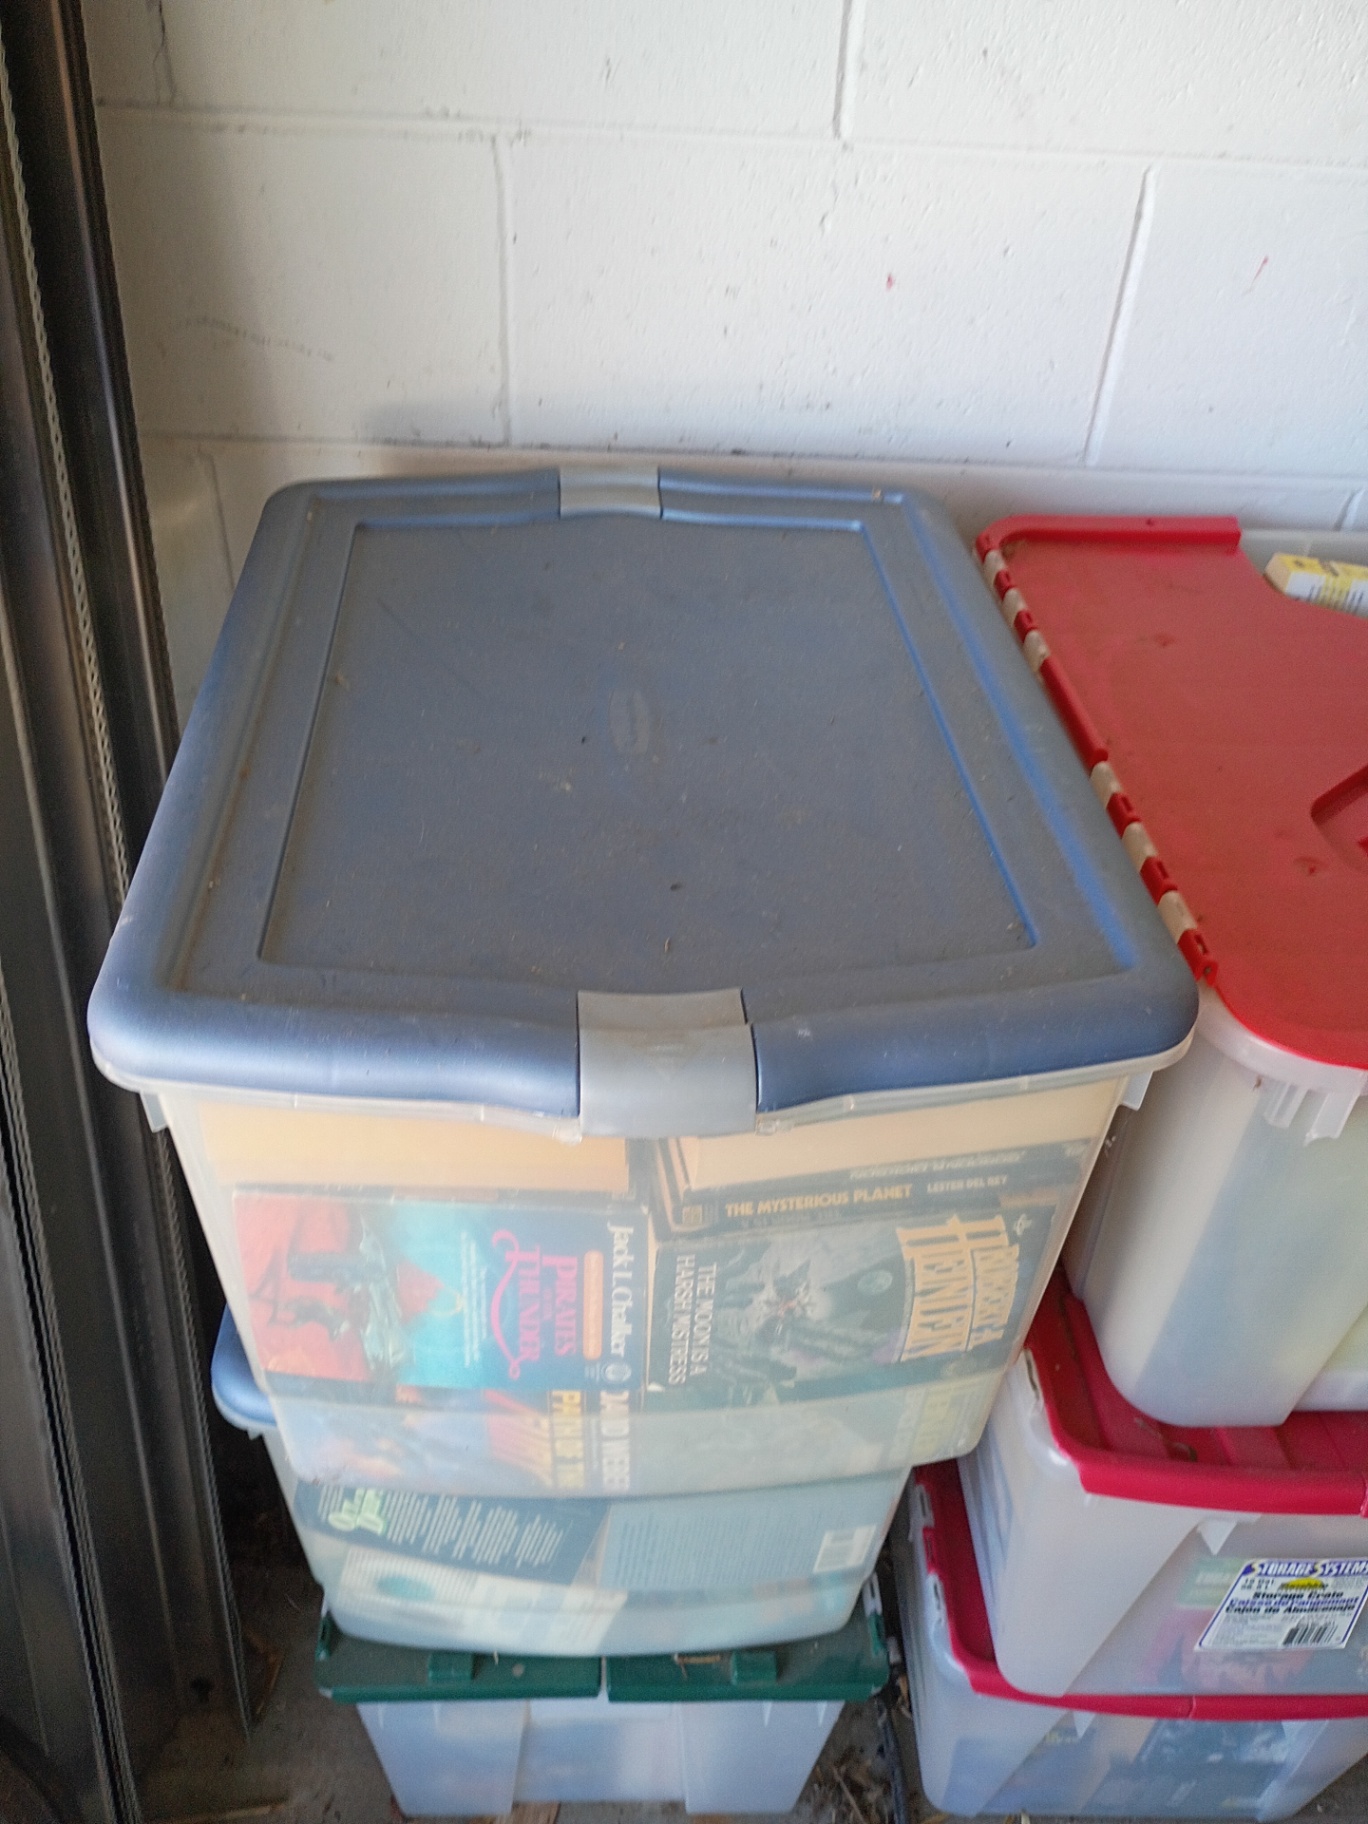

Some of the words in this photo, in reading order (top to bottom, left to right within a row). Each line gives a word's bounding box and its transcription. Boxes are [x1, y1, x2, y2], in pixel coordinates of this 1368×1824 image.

[726, 1201, 753, 1217] THE
[757, 1191, 848, 1214] MYSTERIOUS
[853, 1183, 913, 1202] PLANET
[607, 1221, 634, 1269] Jack
[500, 1240, 540, 1364] THUNDER
[674, 1254, 696, 1310] HARSH
[696, 1262, 717, 1296] THE
[542, 1255, 578, 1356] PIRATES
[609, 1286, 633, 1357] Chalker
[692, 1299, 714, 1346] MOON
[668, 1313, 691, 1385] MISTRESS
[689, 1363, 708, 1376] A
[691, 1348, 710, 1362] IS
[1251, 1559, 1313, 1576] STORAGE
